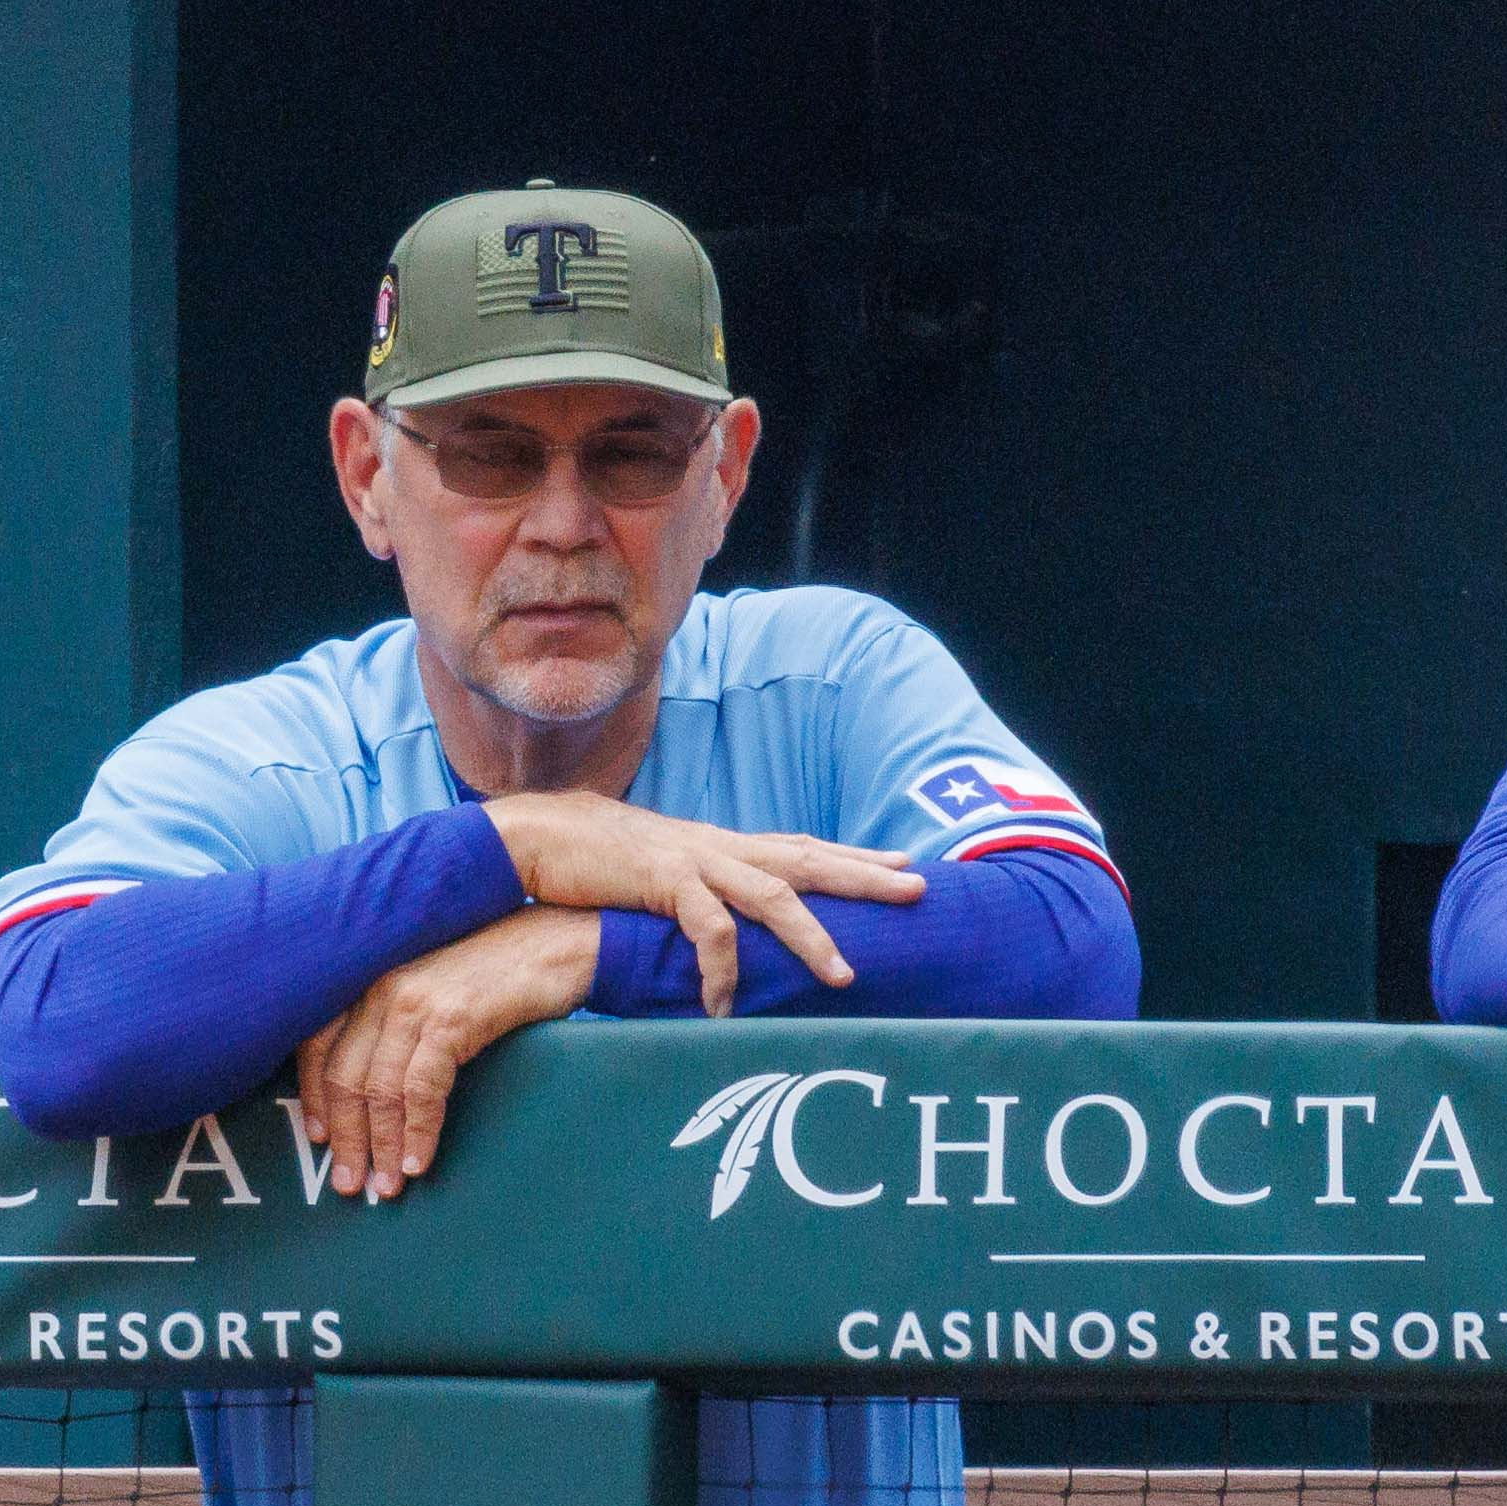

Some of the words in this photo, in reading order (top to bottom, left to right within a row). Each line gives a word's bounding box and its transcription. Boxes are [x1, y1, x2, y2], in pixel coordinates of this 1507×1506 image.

[504, 220, 600, 314] T
[29, 1309, 344, 1361] RESORTS
[837, 1310, 1159, 1361] CASINOS
[1189, 1311, 1231, 1361] &
